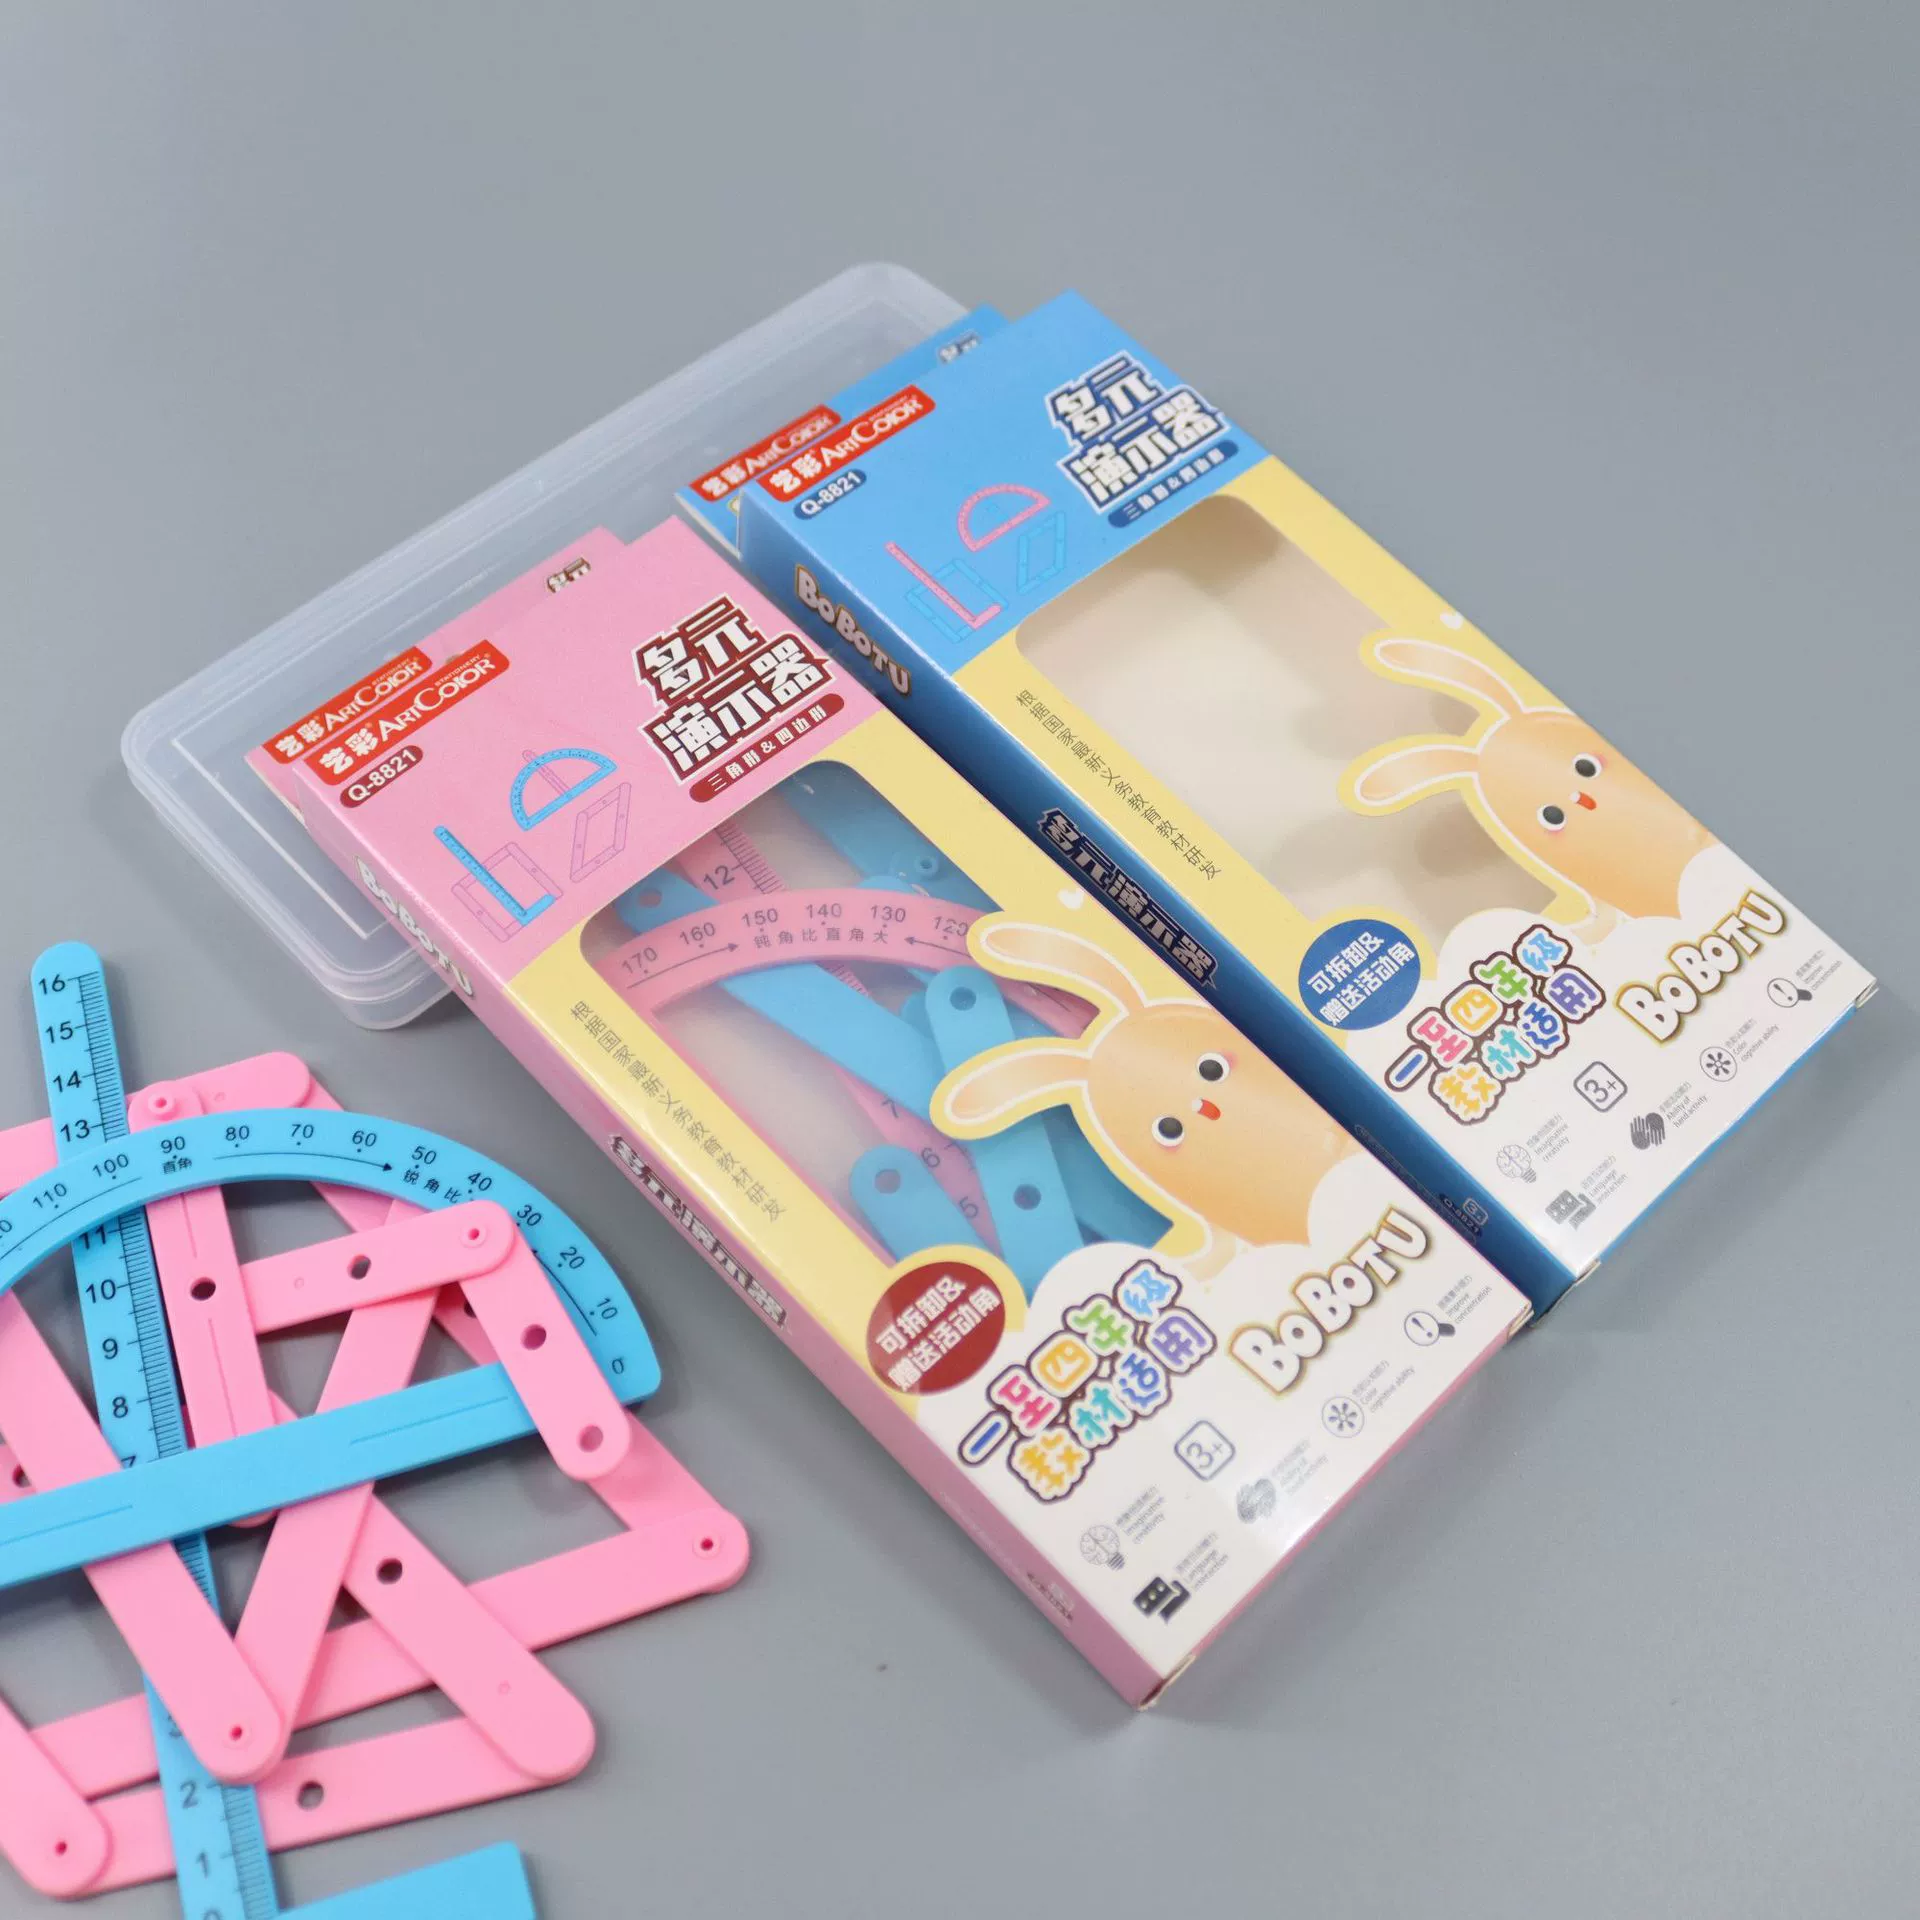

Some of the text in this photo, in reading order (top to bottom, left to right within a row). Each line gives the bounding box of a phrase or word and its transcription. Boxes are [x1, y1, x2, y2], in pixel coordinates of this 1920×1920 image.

[1054, 357, 1159, 441] 多元
[1069, 390, 1219, 502] 演示器
[801, 471, 861, 515] Q-8821
[641, 602, 760, 701] 多元
[653, 638, 824, 773] 演示器
[319, 727, 378, 774] 艺彩
[348, 749, 417, 801] Q-8821
[1016, 690, 1221, 880] 根据国家最新义务教育教材研发
[703, 865, 735, 890] 12
[1046, 813, 1214, 980] 多元演示器
[742, 908, 778, 927] 150
[806, 903, 842, 918] 140
[870, 905, 906, 922] 130
[680, 922, 716, 945] 160
[754, 926, 888, 949] 钝角比直角大
[622, 947, 658, 974] 170
[39, 974, 66, 995] 16
[1319, 942, 1415, 1026] 赠送活动角
[1395, 932, 1564, 1082] 一至四年级
[45, 1021, 74, 1044] 15
[1439, 972, 1598, 1116] 教材适用
[53, 1070, 81, 1093] 14
[1584, 1079, 1617, 1102] 3+
[60, 1119, 90, 1142] 13
[225, 1126, 250, 1142] 80
[290, 1124, 314, 1138] 70
[352, 1130, 377, 1147] 60
[160, 1136, 186, 1154] 90
[411, 1146, 437, 1165] 50
[93, 1154, 129, 1177] 100
[163, 1157, 192, 1175] 直角
[922, 1148, 940, 1168] 6
[468, 1172, 492, 1191] 40
[33, 1183, 67, 1209] 110
[517, 1204, 542, 1227] 30
[559, 1246, 585, 1269] 20
[86, 1279, 116, 1303] 10
[597, 1297, 618, 1320] 10
[102, 1338, 118, 1360] 9
[969, 1268, 1171, 1455] 一至四年级
[112, 1396, 128, 1418] 8
[1018, 1315, 1207, 1490] 教材适用
[1186, 1442, 1223, 1470] 3+
[180, 1780, 199, 1809] 2
[196, 1850, 210, 1879] 1
